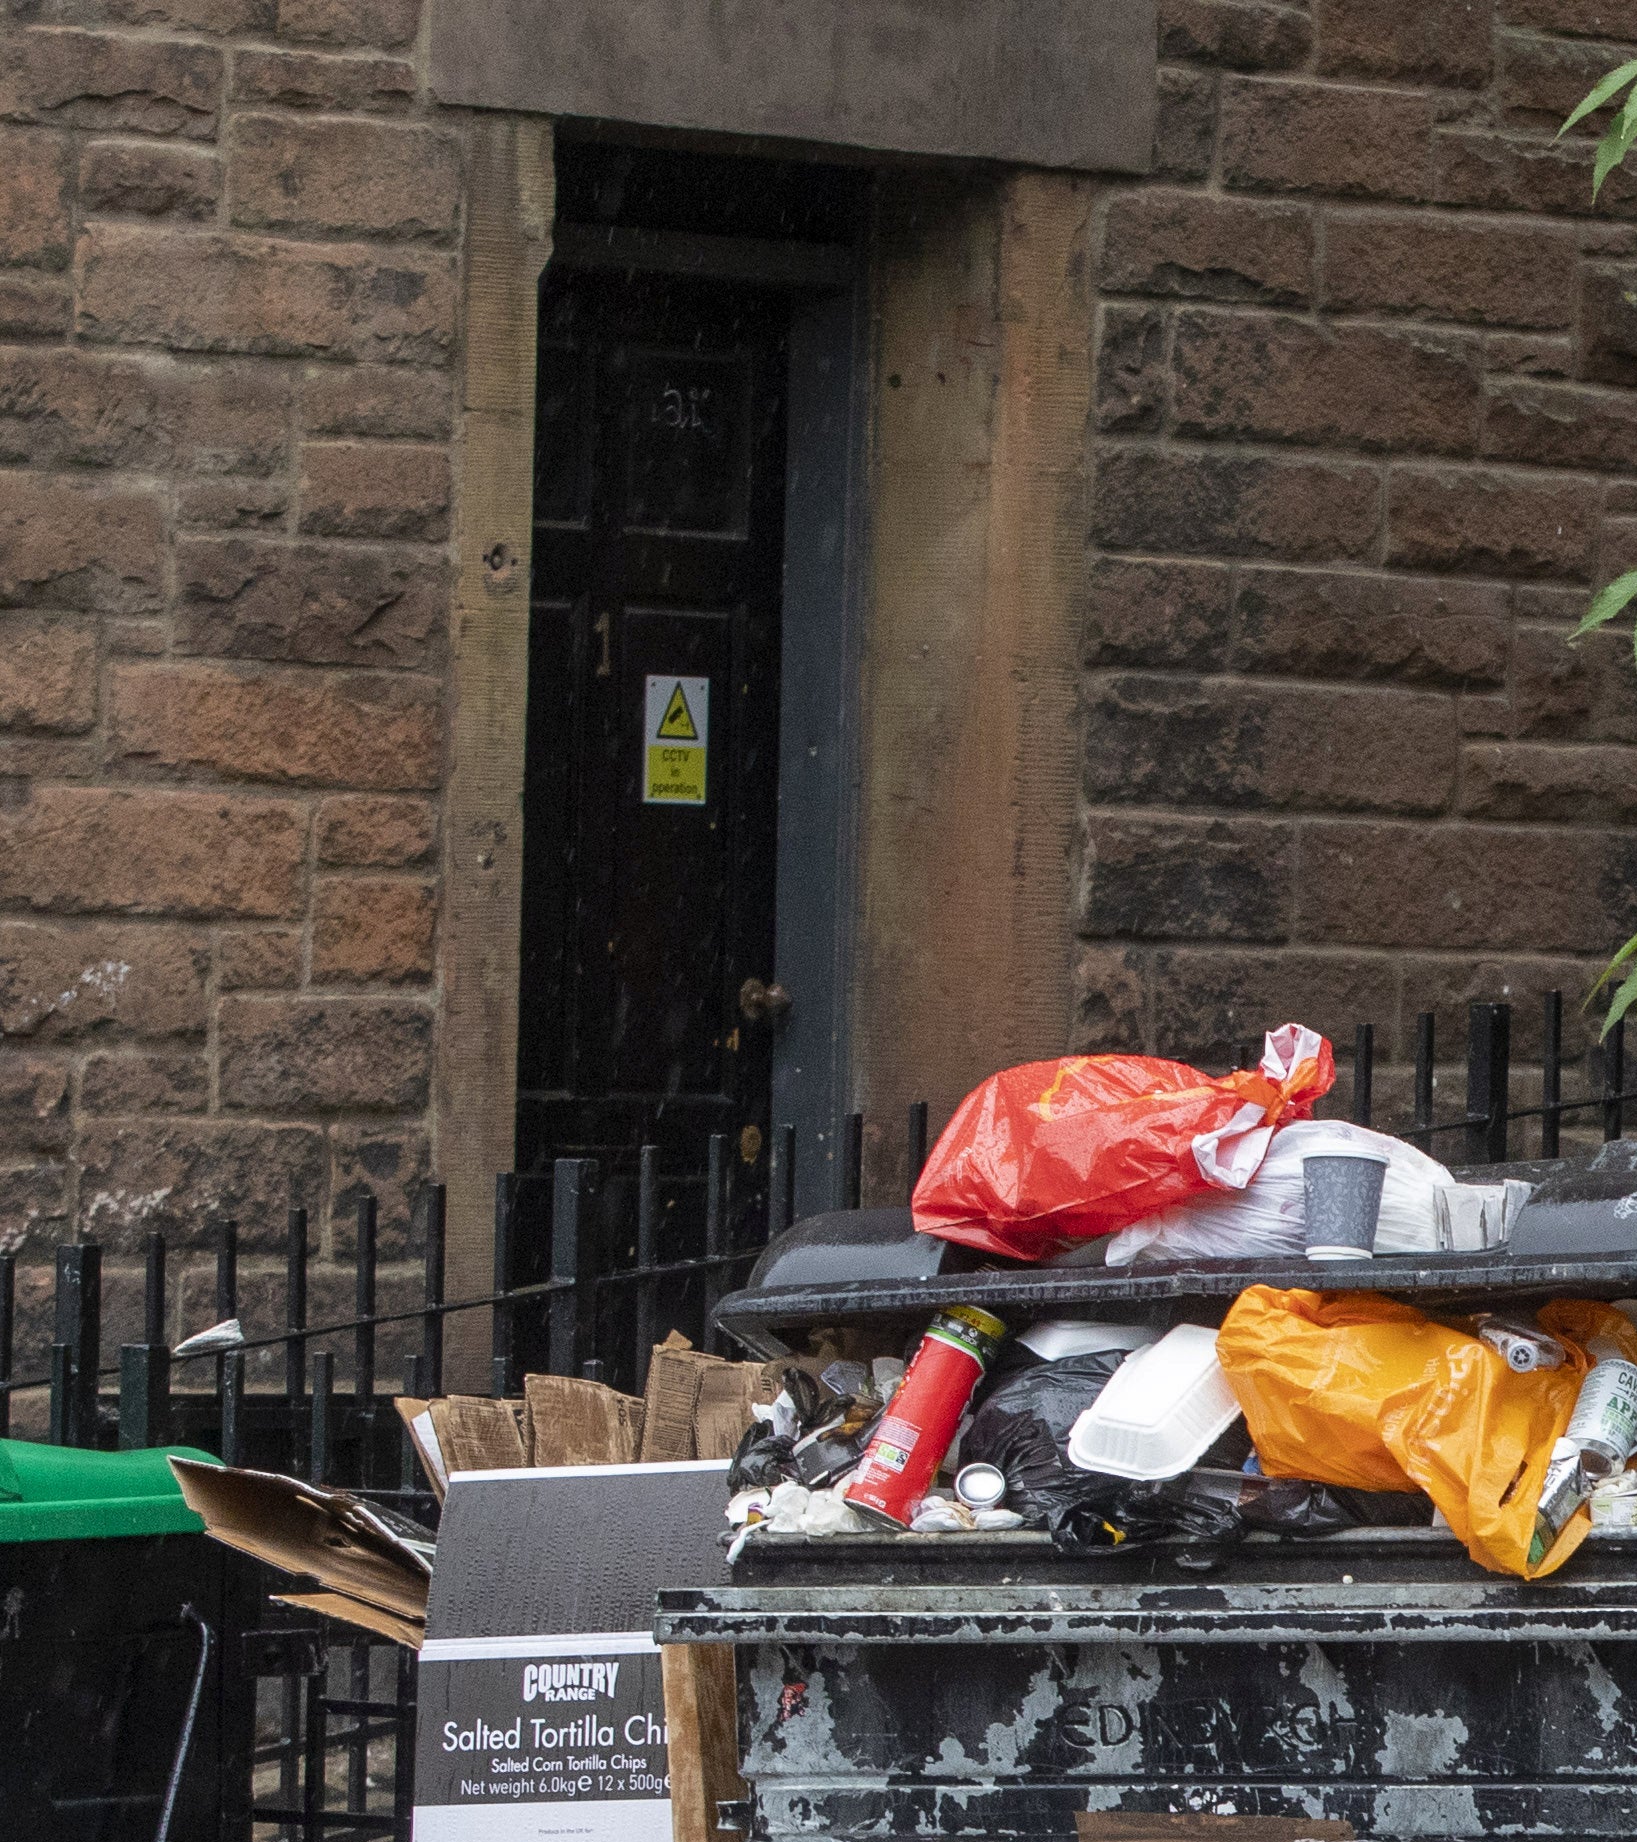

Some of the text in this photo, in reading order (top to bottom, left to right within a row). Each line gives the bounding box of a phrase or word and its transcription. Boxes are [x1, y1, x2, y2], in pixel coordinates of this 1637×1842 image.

[662, 749, 691, 762] CCTV
[523, 1662, 620, 1702] COUNTRY
[545, 1688, 596, 1702] RANGE
[442, 1717, 521, 1752] Salted
[530, 1714, 615, 1748] Tortilla
[491, 1753, 647, 1774] Salted Corn Tortilla Chips
[461, 1779, 485, 1796] Net
[489, 1776, 535, 1799] weight
[598, 1775, 614, 1792] 12
[617, 1780, 625, 1791] x
